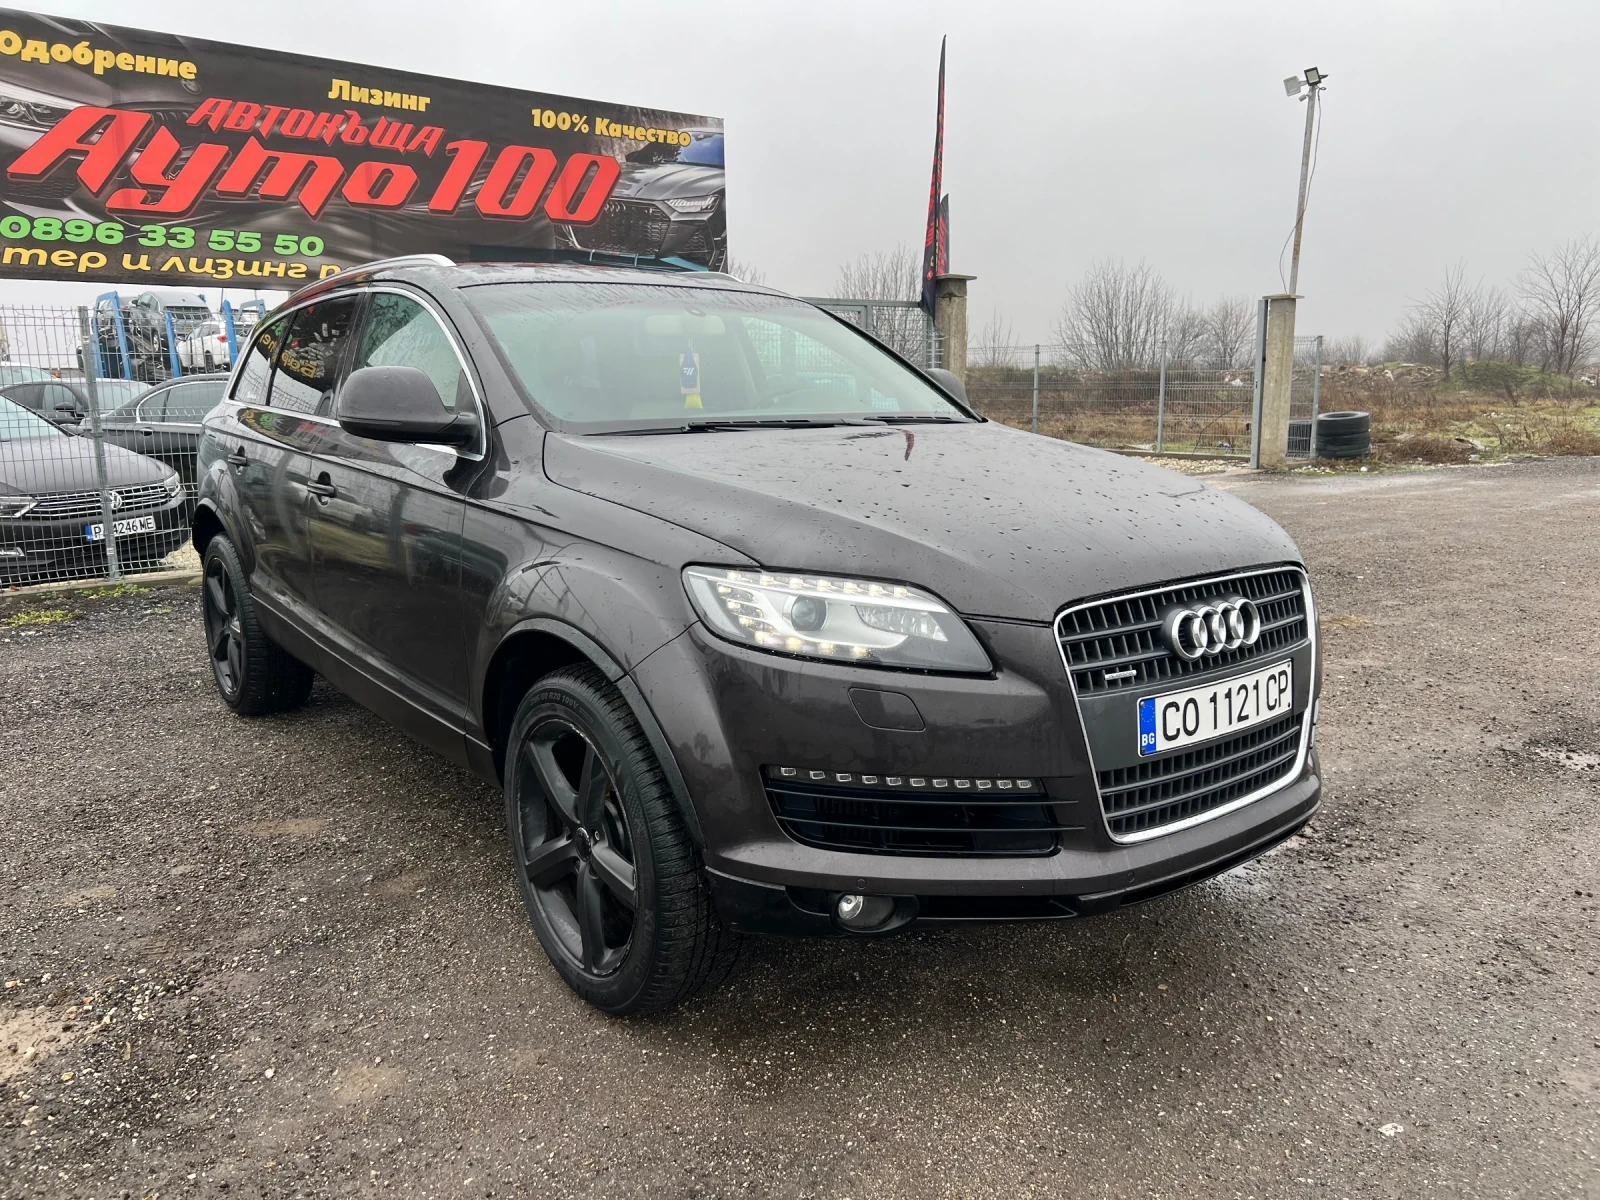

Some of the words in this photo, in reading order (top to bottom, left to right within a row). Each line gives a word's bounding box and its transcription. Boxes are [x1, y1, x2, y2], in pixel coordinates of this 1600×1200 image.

[0, 30, 197, 80] Одобрение
[328, 78, 431, 113] Лизинг
[531, 108, 589, 135] 100%
[595, 116, 692, 147] Качество
[428, 139, 622, 223] 100
[0, 215, 124, 245] 0896
[138, 225, 196, 249] 33
[207, 229, 262, 254] 55
[273, 235, 325, 257] 50
[122, 253, 152, 271] и
[1162, 697, 1200, 741] CO
[1209, 679, 1260, 730] 1121
[1266, 669, 1288, 711] CP
[1141, 732, 1155, 747] BG
